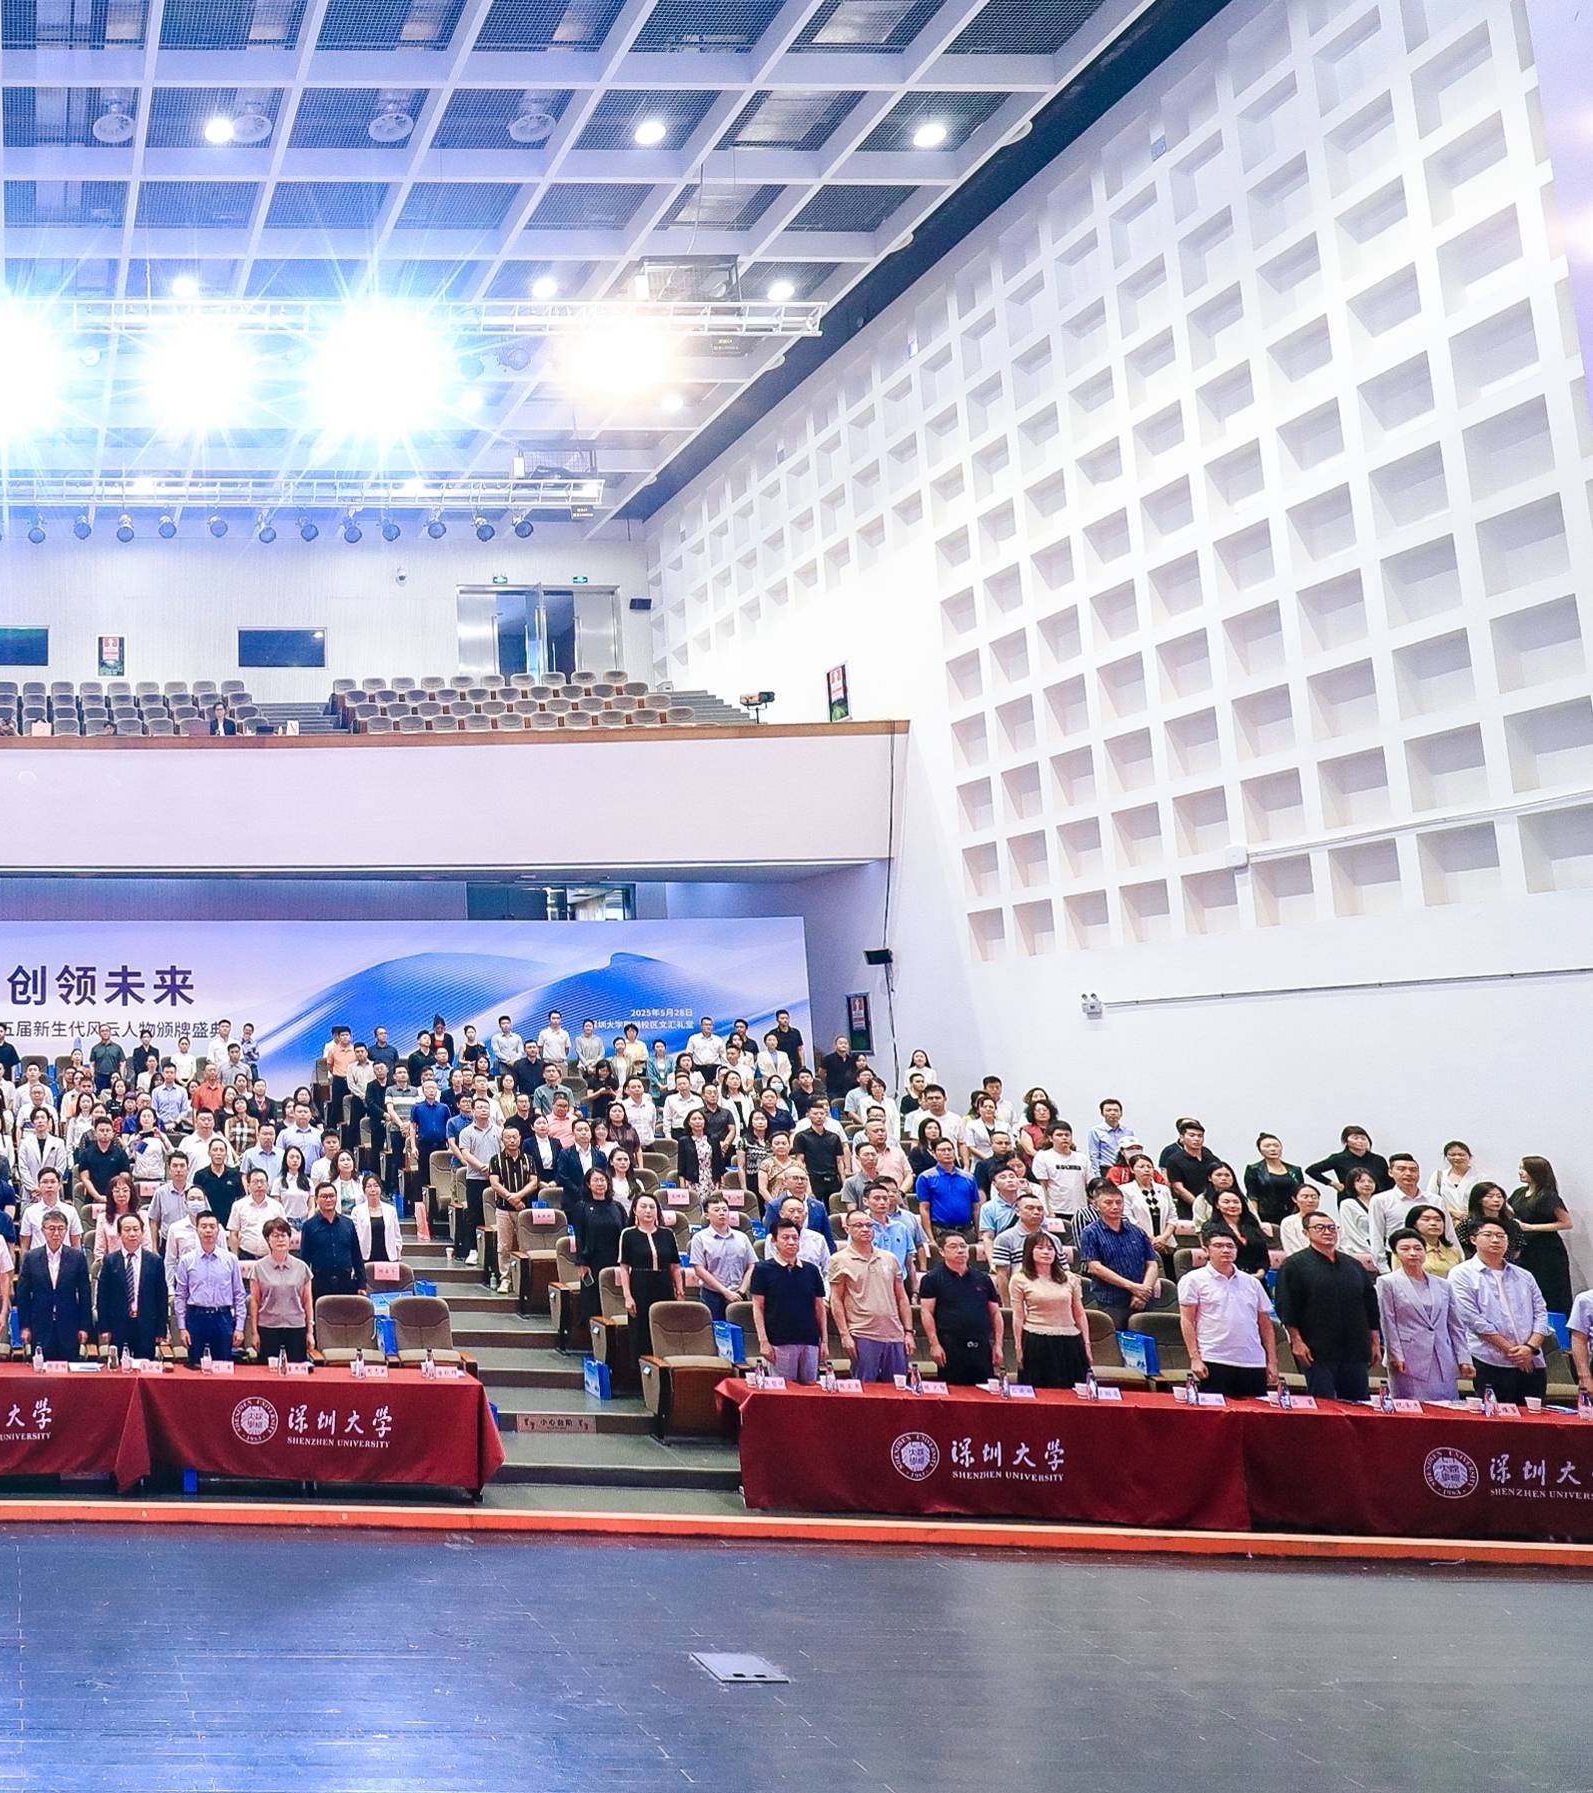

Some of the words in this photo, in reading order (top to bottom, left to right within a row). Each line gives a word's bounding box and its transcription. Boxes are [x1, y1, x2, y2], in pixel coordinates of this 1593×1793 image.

[6, 964, 194, 1007] 创领未来
[631, 1008, 692, 1017] 2025年5月28日
[288, 1404, 393, 1438] 深圳大学
[0, 1432, 51, 1441] UNIVERSITY
[287, 1437, 334, 1446] SHENZHEN
[337, 1439, 390, 1448] UNIVERSITY
[952, 1437, 1064, 1471] 深圳大学
[1490, 1453, 1593, 1486] 深圳大
[952, 1470, 1002, 1479] SHENZHEN
[1005, 1471, 1064, 1482] UNIVERSITY
[1490, 1488, 1546, 1498] SHENZHEN
